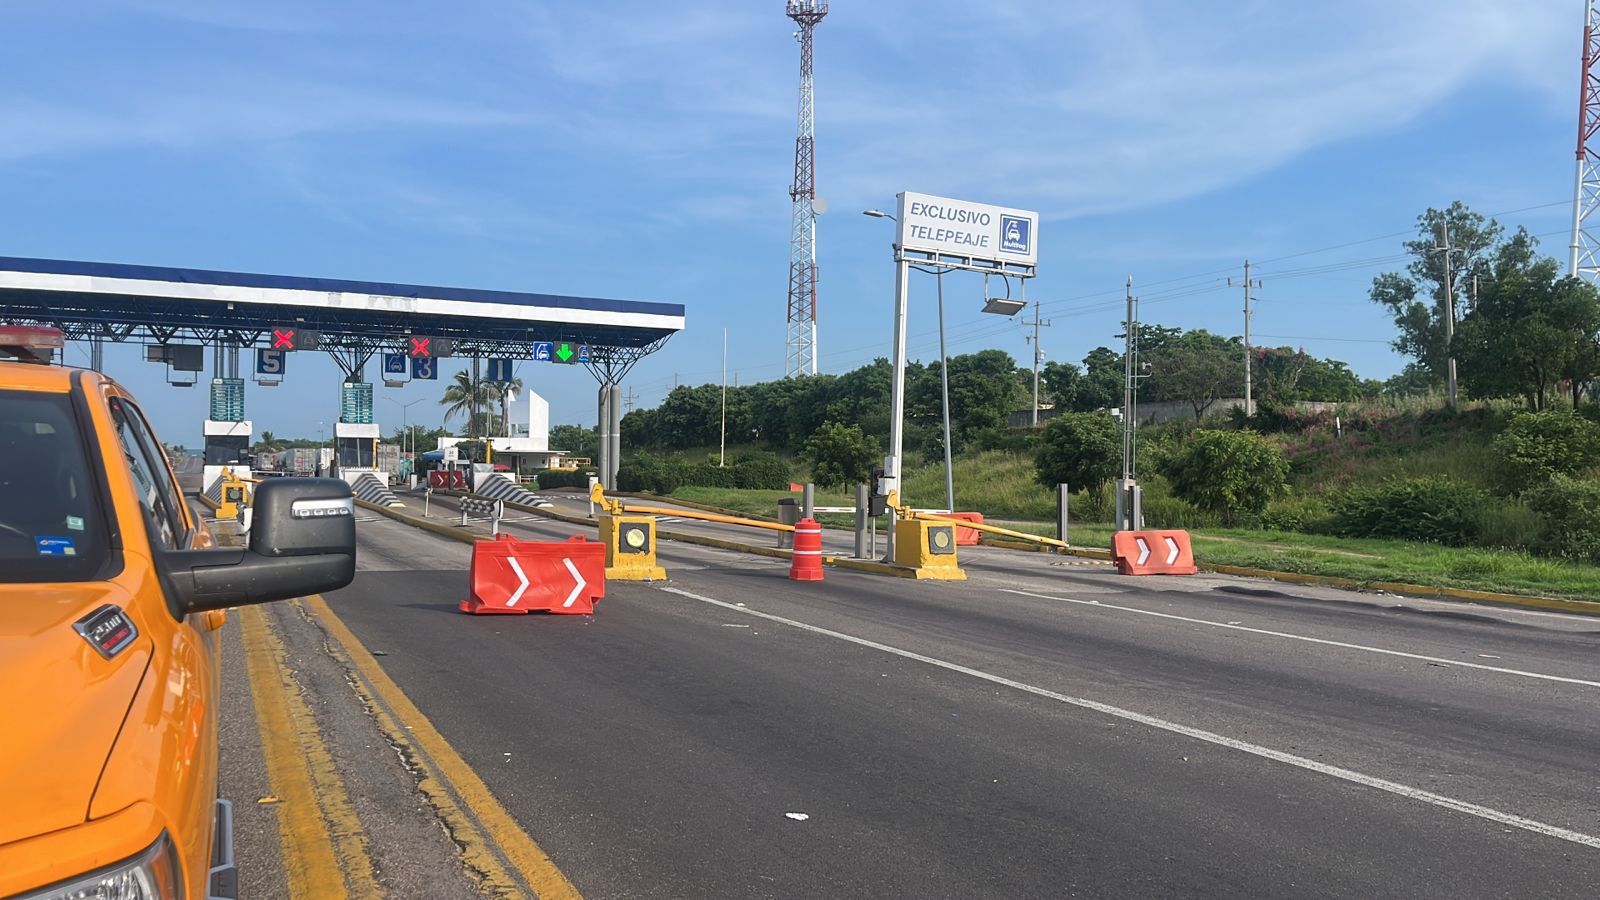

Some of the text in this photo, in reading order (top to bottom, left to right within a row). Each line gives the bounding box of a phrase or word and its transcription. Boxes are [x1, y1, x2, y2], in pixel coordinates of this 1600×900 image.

[911, 202, 990, 226] EXCLUSIVO
[911, 225, 989, 248] TELEPEAJE
[263, 350, 280, 373] 5
[418, 357, 431, 378] 3
